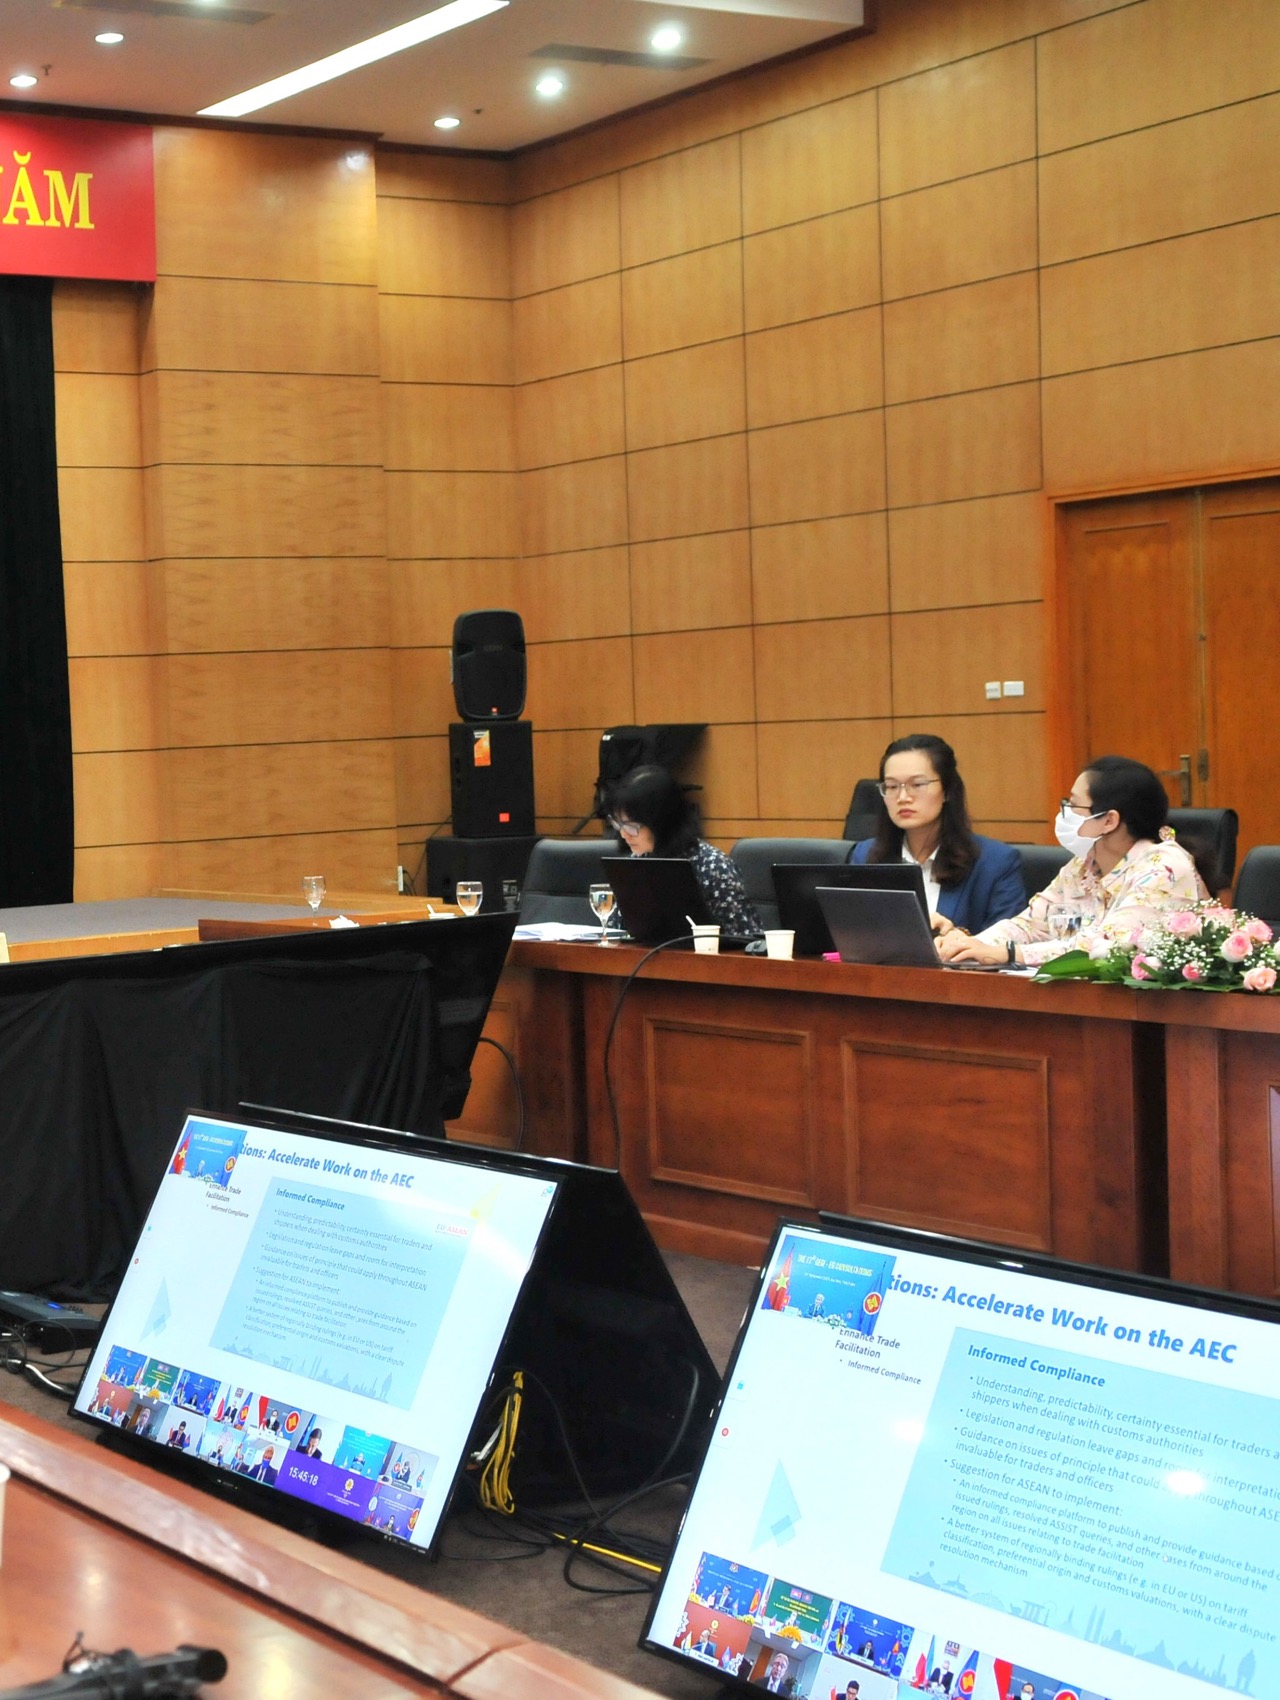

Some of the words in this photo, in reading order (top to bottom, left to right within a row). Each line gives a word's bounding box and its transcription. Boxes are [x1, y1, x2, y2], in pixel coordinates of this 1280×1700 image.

[875, 1335, 901, 1349] Trade
[941, 1284, 1047, 1323] Accelerate
[1048, 1307, 1110, 1336] Work
[1112, 1324, 1142, 1344] on
[1145, 1327, 1185, 1353] the
[1188, 1336, 1238, 1364] AEC
[834, 1339, 882, 1358] Facilitation
[966, 1344, 1027, 1369] Informed
[1028, 1358, 1107, 1389] Compliance
[846, 1358, 880, 1374] Informed
[879, 1367, 922, 1386] Compliance
[964, 1407, 1015, 1430] Legislation
[1015, 1420, 1035, 1434] and
[1035, 1425, 1087, 1449] regulation
[1086, 1438, 1115, 1455] leave
[1115, 1448, 1140, 1463] gaps
[1141, 1452, 1163, 1468] and
[970, 1389, 1011, 1409] shippers
[1010, 1399, 1039, 1415] when
[1039, 1406, 1076, 1425] dealing
[1076, 1415, 1101, 1431] with
[1100, 1423, 1145, 1442] customs
[1145, 1433, 1205, 1458] authorities
[974, 1375, 1047, 1404] Understanding,
[1047, 1393, 1115, 1420] predictability,
[1115, 1410, 1163, 1432] certainty
[1163, 1421, 1211, 1443] essential
[1211, 1433, 1229, 1447] for
[1230, 1438, 1272, 1457] traders
[954, 1439, 1003, 1462] invaluable
[1003, 1452, 1018, 1466] for
[1018, 1457, 1055, 1476] traders
[1054, 1466, 1076, 1482] and
[1075, 1472, 1115, 1492] officers
[958, 1425, 1004, 1447] Guidance
[1004, 1440, 1017, 1450] on
[1018, 1441, 1049, 1459] issues
[1048, 1449, 1061, 1462] of
[1061, 1453, 1107, 1475] principle
[1106, 1465, 1130, 1481] that
[288, 1466, 319, 1486] 15:45:18
[949, 1458, 1001, 1483] Suggestion
[1000, 1472, 1016, 1486] for
[1016, 1476, 1050, 1495] ASEAN
[1051, 1487, 1063, 1499] to
[1161, 1554, 1187, 1567] ases
